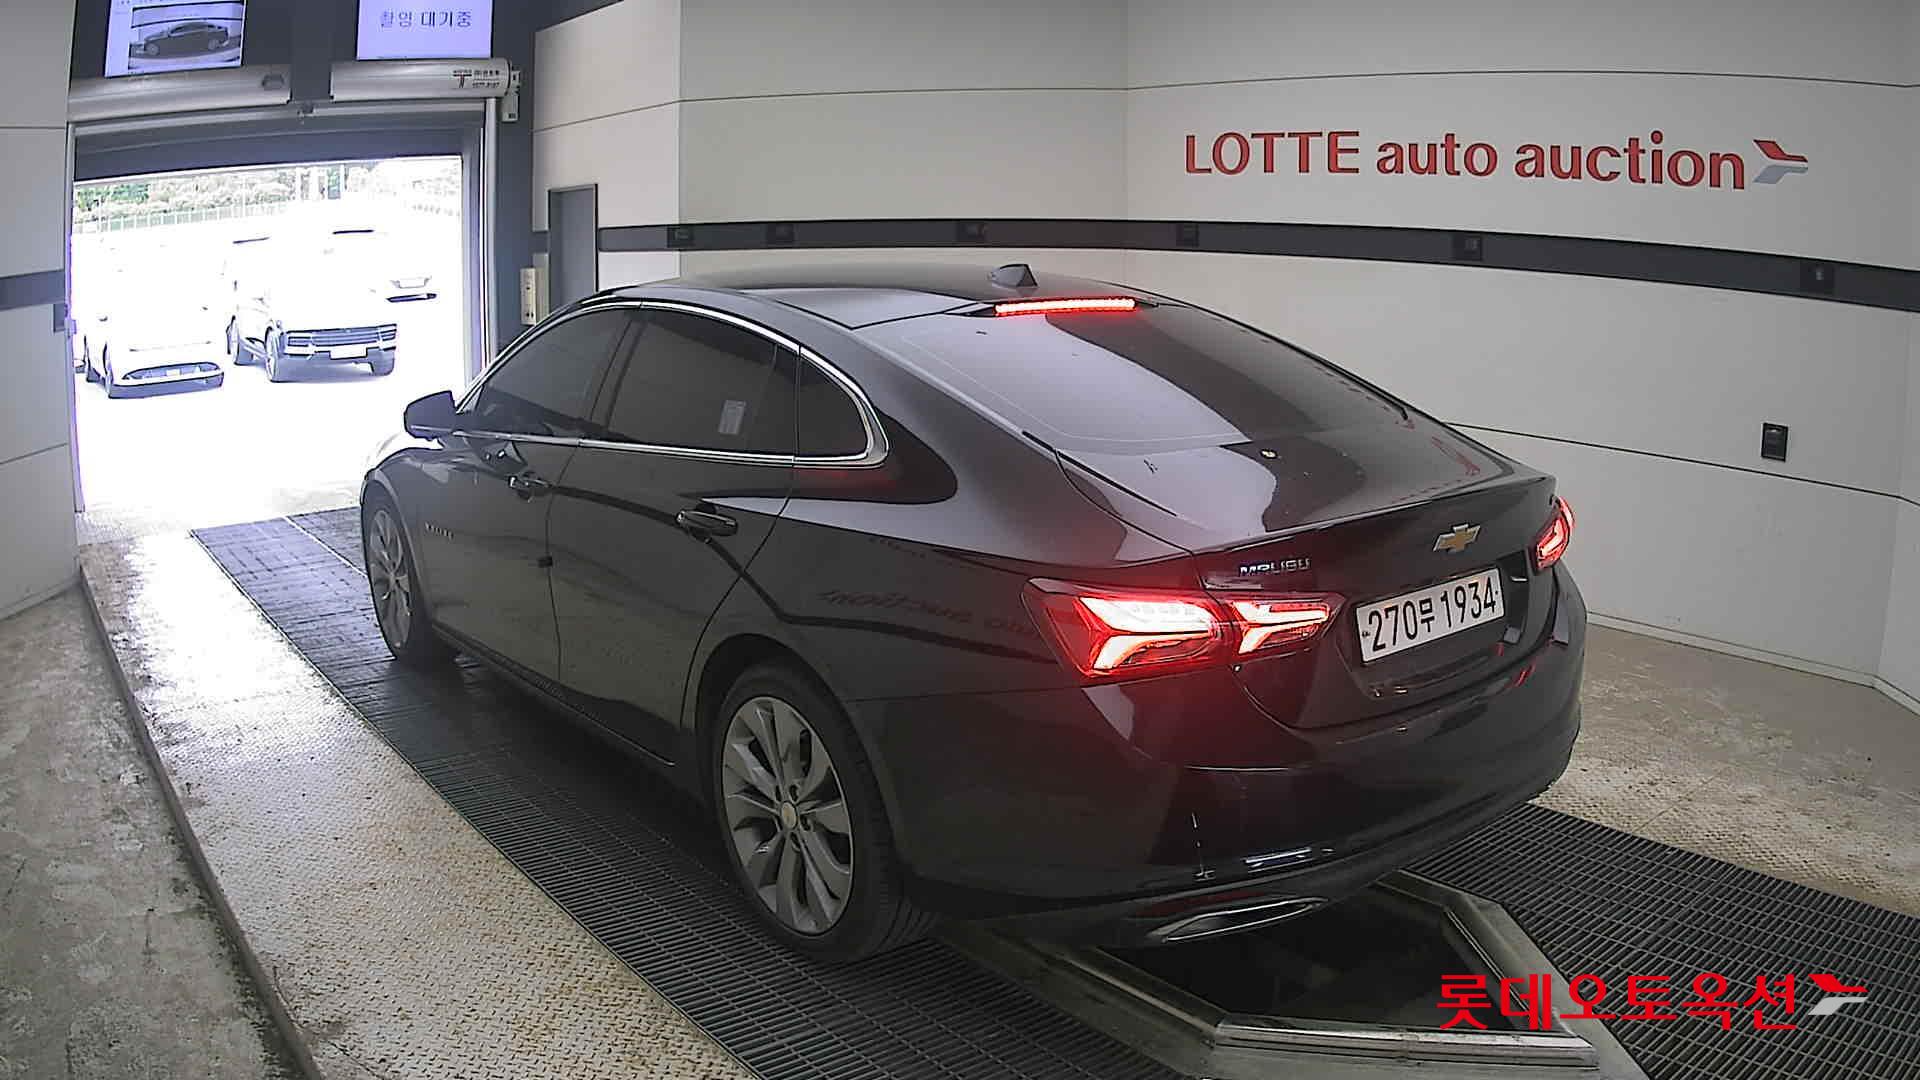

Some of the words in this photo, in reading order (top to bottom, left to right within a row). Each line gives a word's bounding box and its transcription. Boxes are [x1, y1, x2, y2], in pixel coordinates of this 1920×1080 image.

[421, 11, 471, 27] 대기중
[1185, 131, 1359, 175] LOTTE
[1376, 132, 1497, 176] auto
[1514, 130, 1745, 190] auction
